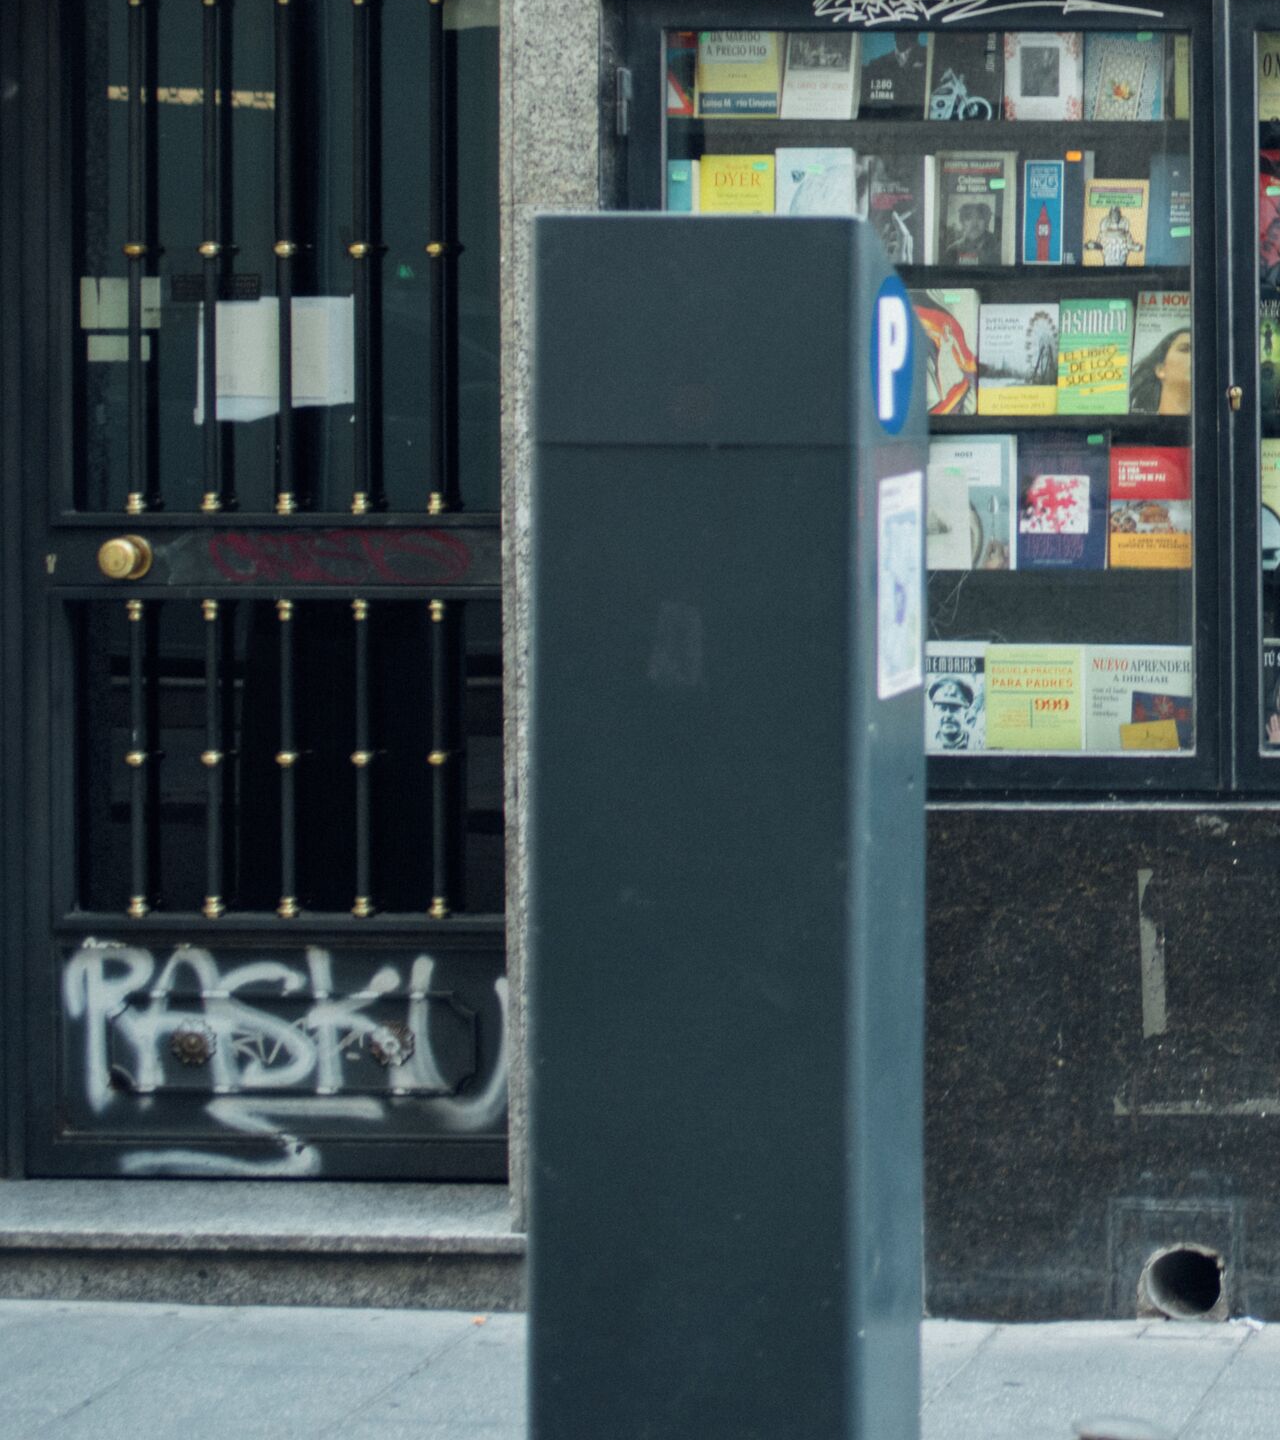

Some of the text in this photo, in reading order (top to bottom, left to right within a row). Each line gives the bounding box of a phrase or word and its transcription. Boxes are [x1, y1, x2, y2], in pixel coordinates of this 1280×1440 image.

[714, 170, 762, 188] DYER
[1061, 308, 1128, 336] ASIMOV
[1069, 359, 1114, 374] DE LOS
[1065, 369, 1122, 386] SUCESOS
[1091, 658, 1192, 673] NUEVO APRENDER
[991, 677, 1074, 688] PARA PADRES
